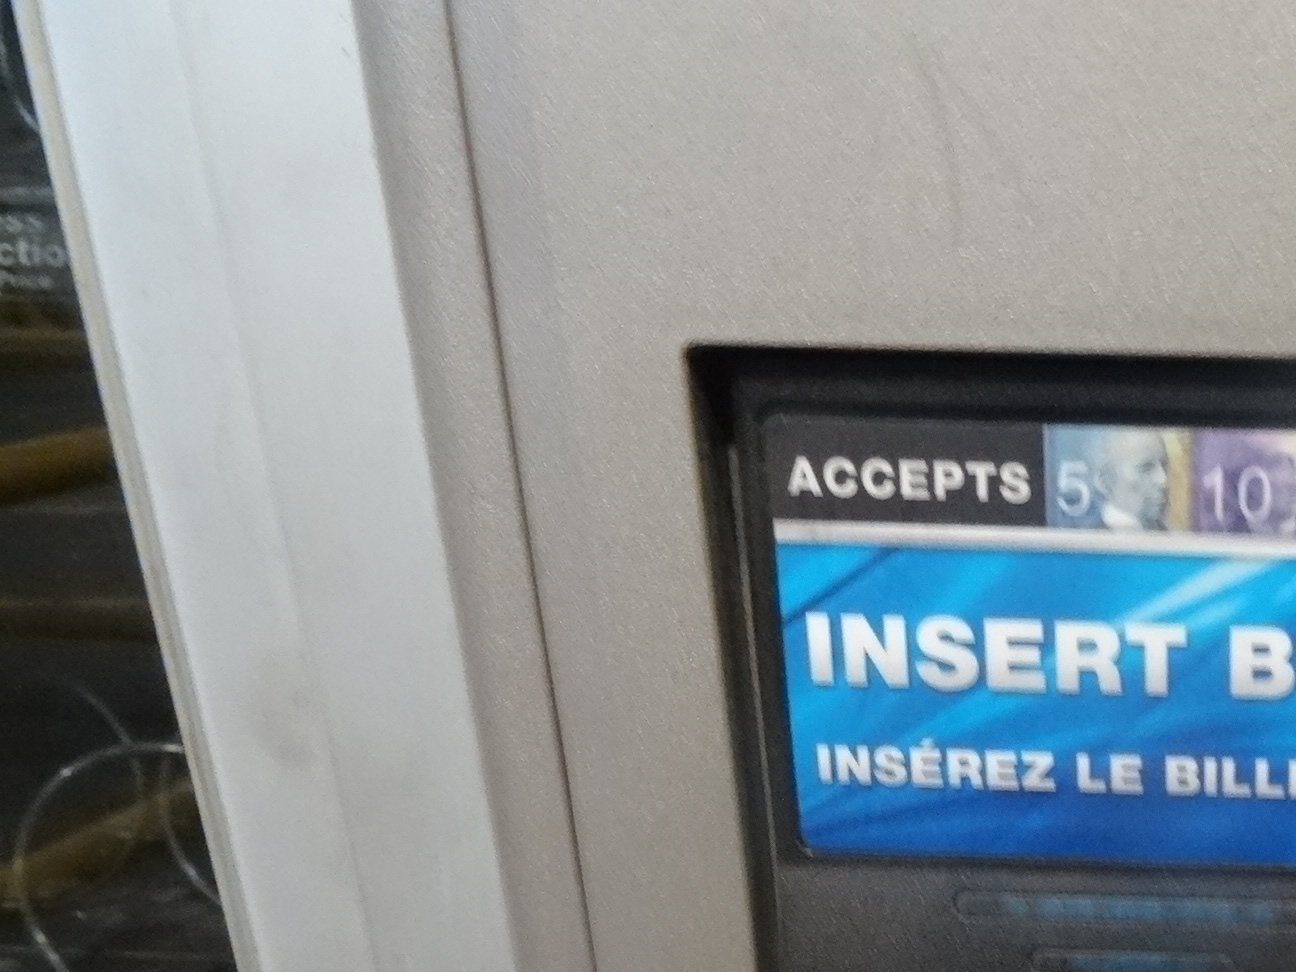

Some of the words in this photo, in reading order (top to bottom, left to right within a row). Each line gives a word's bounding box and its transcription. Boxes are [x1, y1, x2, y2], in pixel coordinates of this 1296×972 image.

[787, 455, 1032, 505] ACCEPTS
[1056, 461, 1090, 518] 5
[1203, 463, 1272, 524] 10
[804, 611, 1188, 698] INSERT
[815, 737, 1056, 793] INSÉREZ
[1076, 752, 1143, 796] LE
